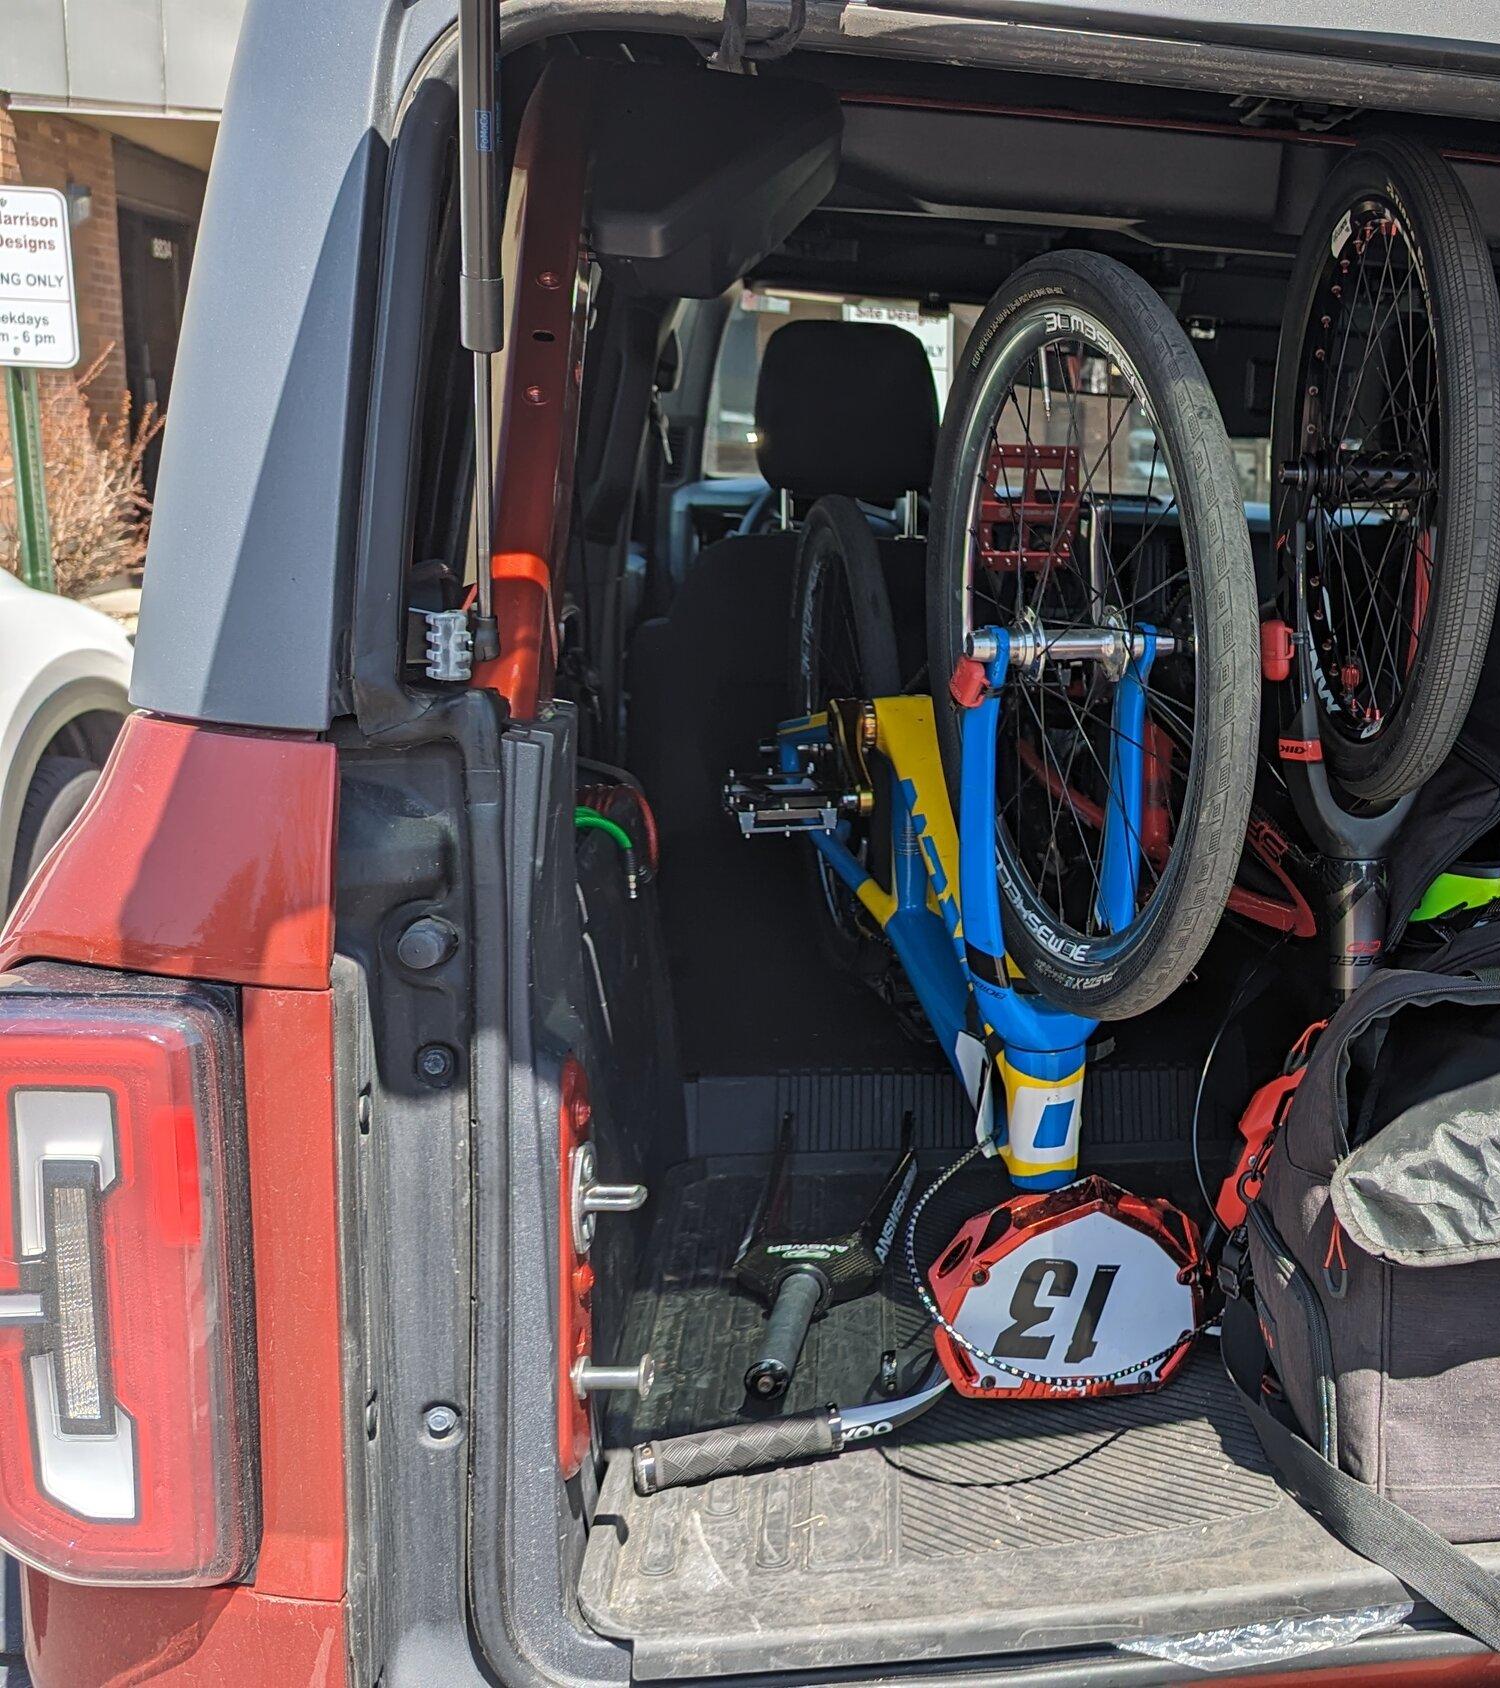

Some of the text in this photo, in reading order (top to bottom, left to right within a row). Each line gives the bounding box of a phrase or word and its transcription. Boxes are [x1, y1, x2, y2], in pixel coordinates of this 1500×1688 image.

[479, 112, 489, 150] FoMoCo
[0, 211, 59, 228] arrison
[25, 273, 65, 288] ONLY
[0, 311, 50, 330] ekdays
[22, 330, 31, 343] 6
[34, 333, 56, 347] pm
[874, 1188, 909, 1265] ANSWER
[765, 1243, 850, 1254] ANSWER
[990, 1257, 1122, 1364] 13
